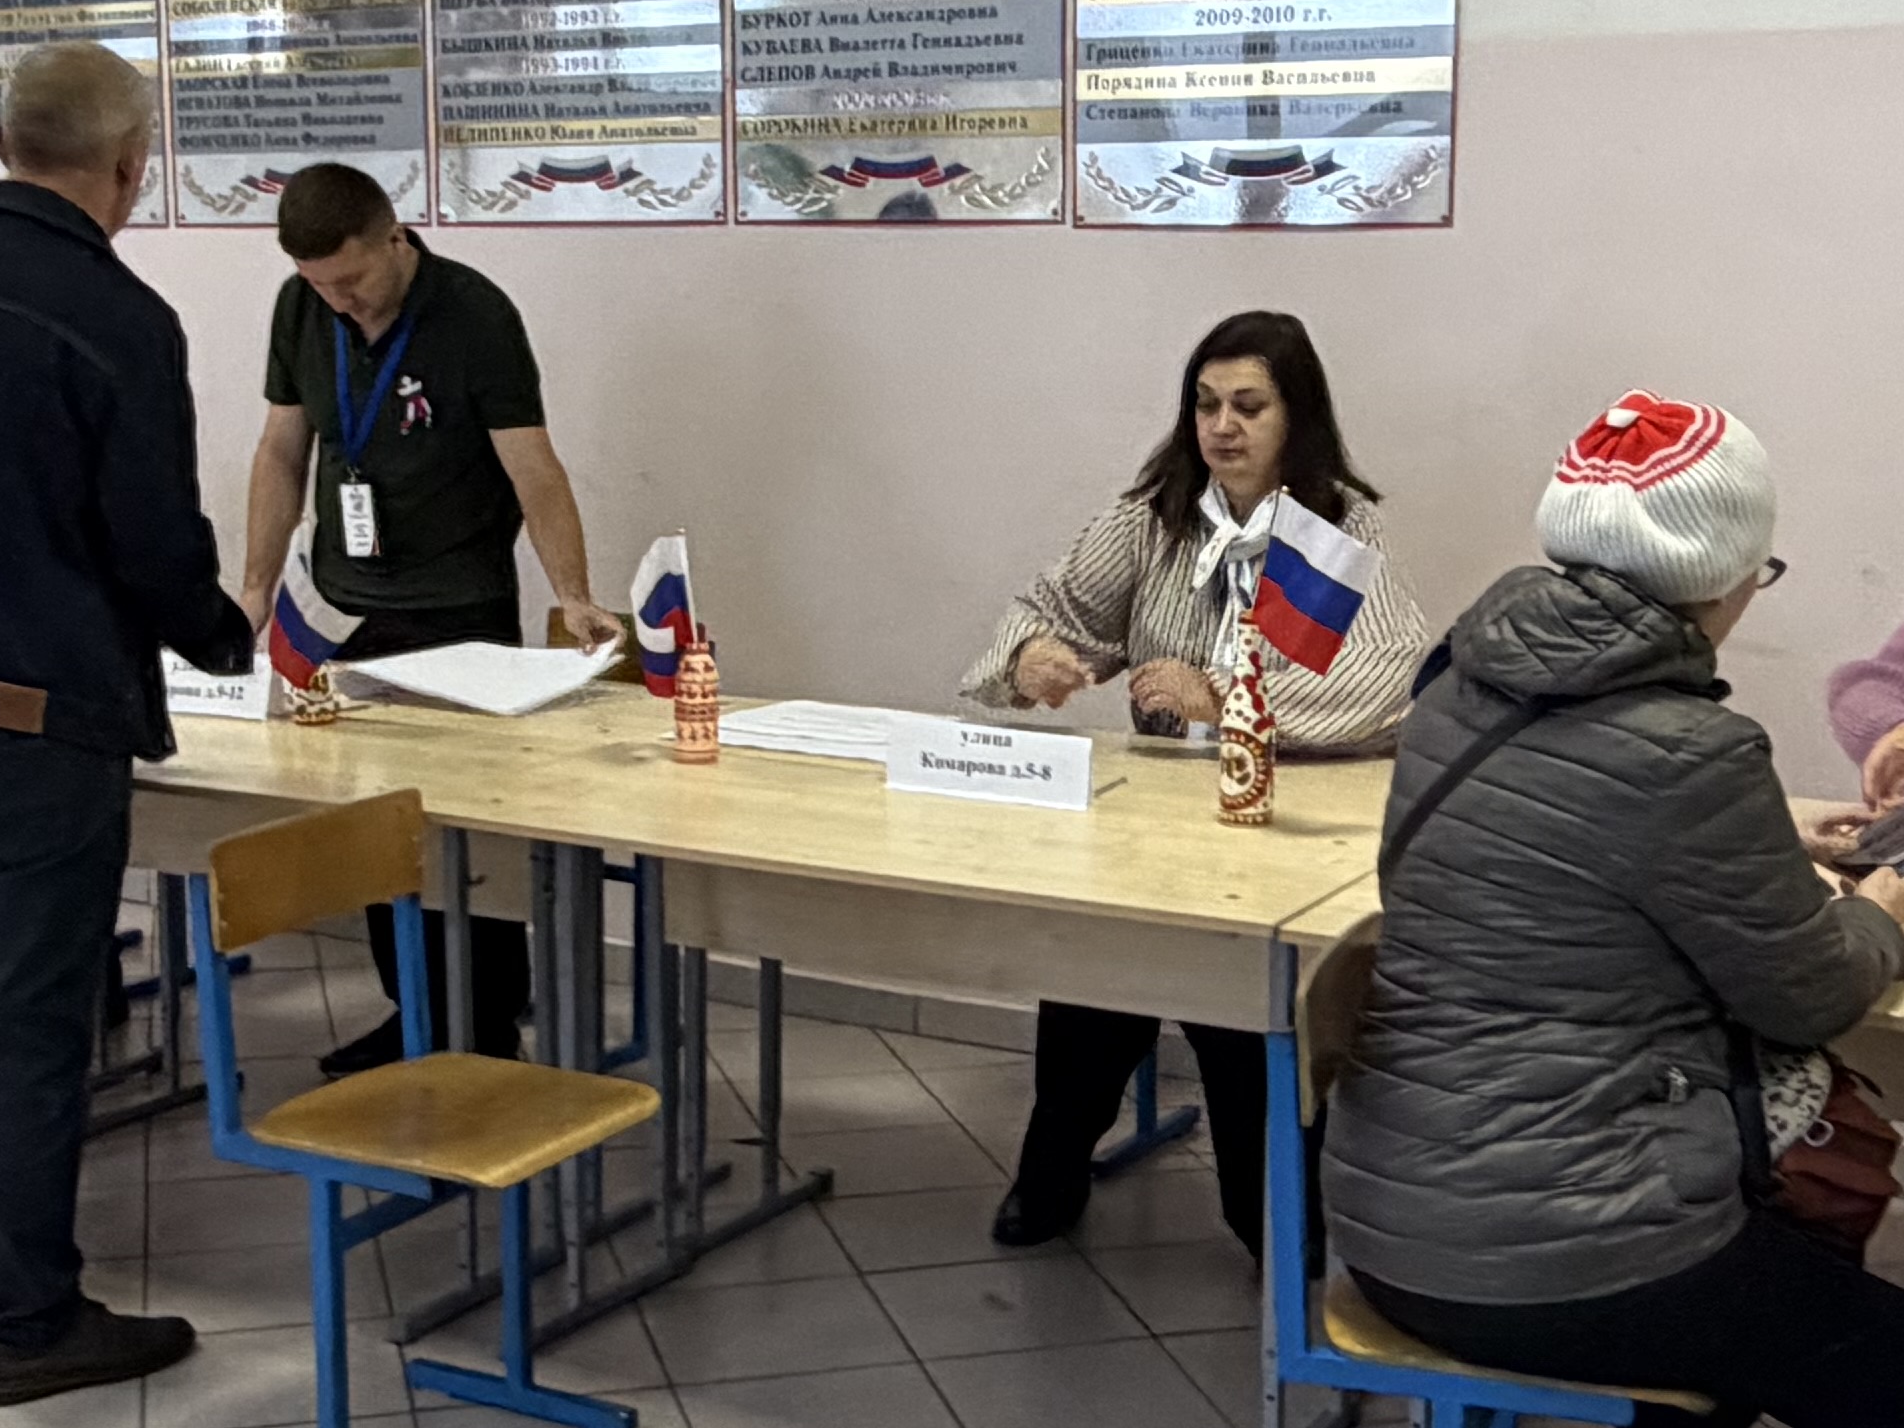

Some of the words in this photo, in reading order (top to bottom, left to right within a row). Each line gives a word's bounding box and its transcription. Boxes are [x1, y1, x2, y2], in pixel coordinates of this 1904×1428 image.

[741, 11, 811, 29] БУРКОТ
[817, 10, 858, 26] Анна
[865, 6, 997, 24] Александровна
[1194, 6, 1295, 26] 2009-2010
[1303, 9, 1332, 22] г.г.
[912, 33, 1023, 49] Геннадьевна
[740, 64, 815, 82] СЛЕПОВ
[821, 62, 881, 82] Андрей
[887, 61, 1017, 78] Владимирович
[1185, 72, 1253, 87] Ксения
[1261, 69, 1375, 85] Васильевна
[849, 117, 937, 134] Екатерина
[945, 115, 1027, 132] Игоревна
[960, 730, 1013, 747] улица
[919, 751, 1007, 777] Комарова
